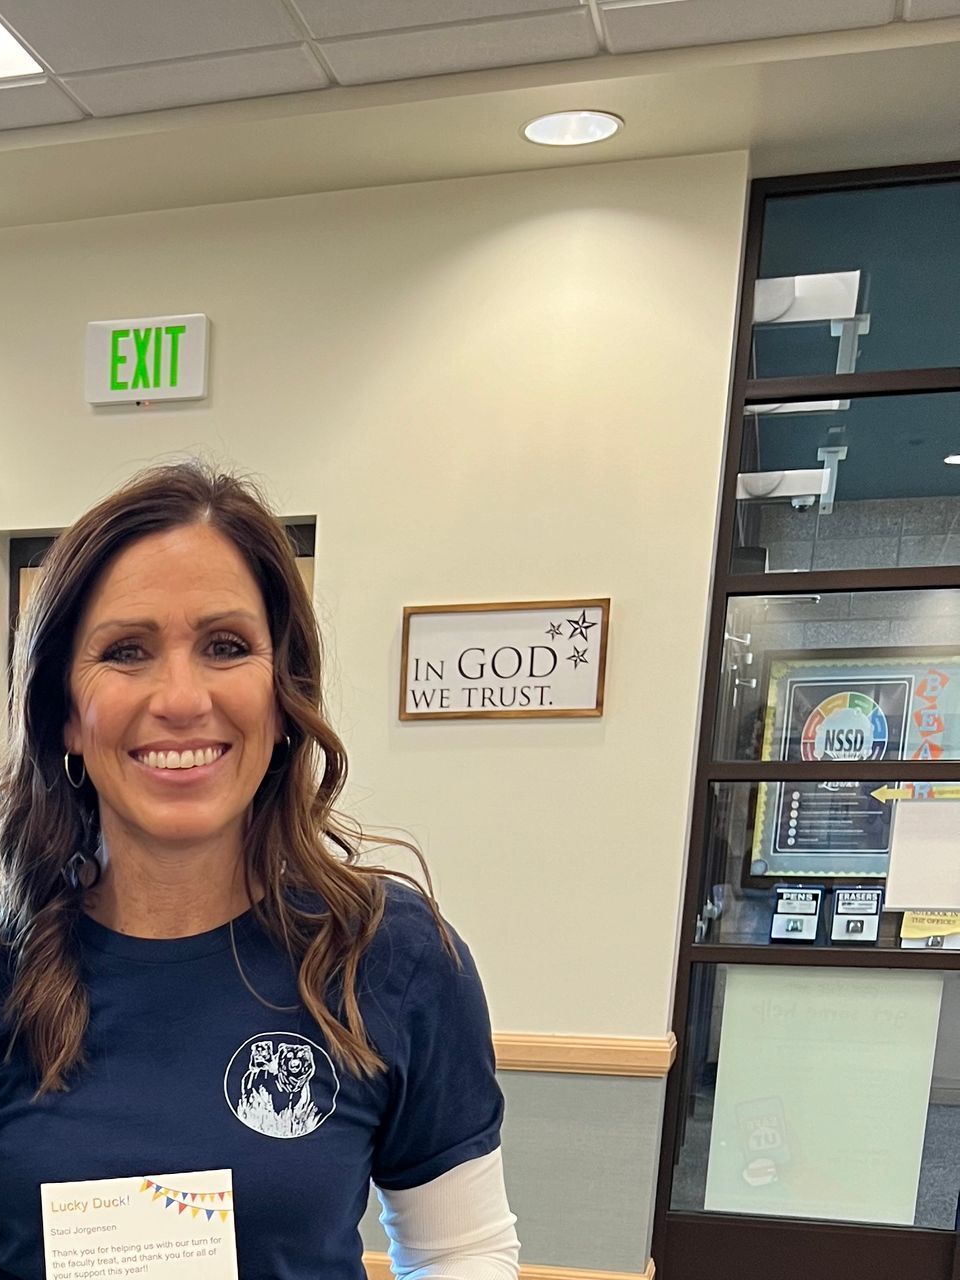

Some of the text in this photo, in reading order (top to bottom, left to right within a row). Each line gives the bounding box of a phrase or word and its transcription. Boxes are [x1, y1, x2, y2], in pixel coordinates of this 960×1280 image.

[110, 325, 186, 391] EXIT
[413, 645, 558, 682] IN GOD
[411, 685, 553, 710] WE TRUST.
[824, 728, 865, 752] NSSD
[782, 893, 813, 901] PENS
[838, 892, 878, 901] ERASERS
[51, 1194, 131, 1213] Lucky Duck!
[50, 1223, 117, 1236] Staci Jorgensen
[52, 1248, 78, 1258] Thank
[80, 1248, 95, 1257] you
[97, 1246, 109, 1254] for
[111, 1243, 142, 1253] helping
[156, 1240, 173, 1249] with
[175, 1240, 190, 1248] our
[191, 1238, 208, 1246] turn
[210, 1236, 222, 1244] for
[52, 1247, 217, 1269] the faculty treat, and thank you for all of
[53, 1264, 149, 1280] your support this year!!
